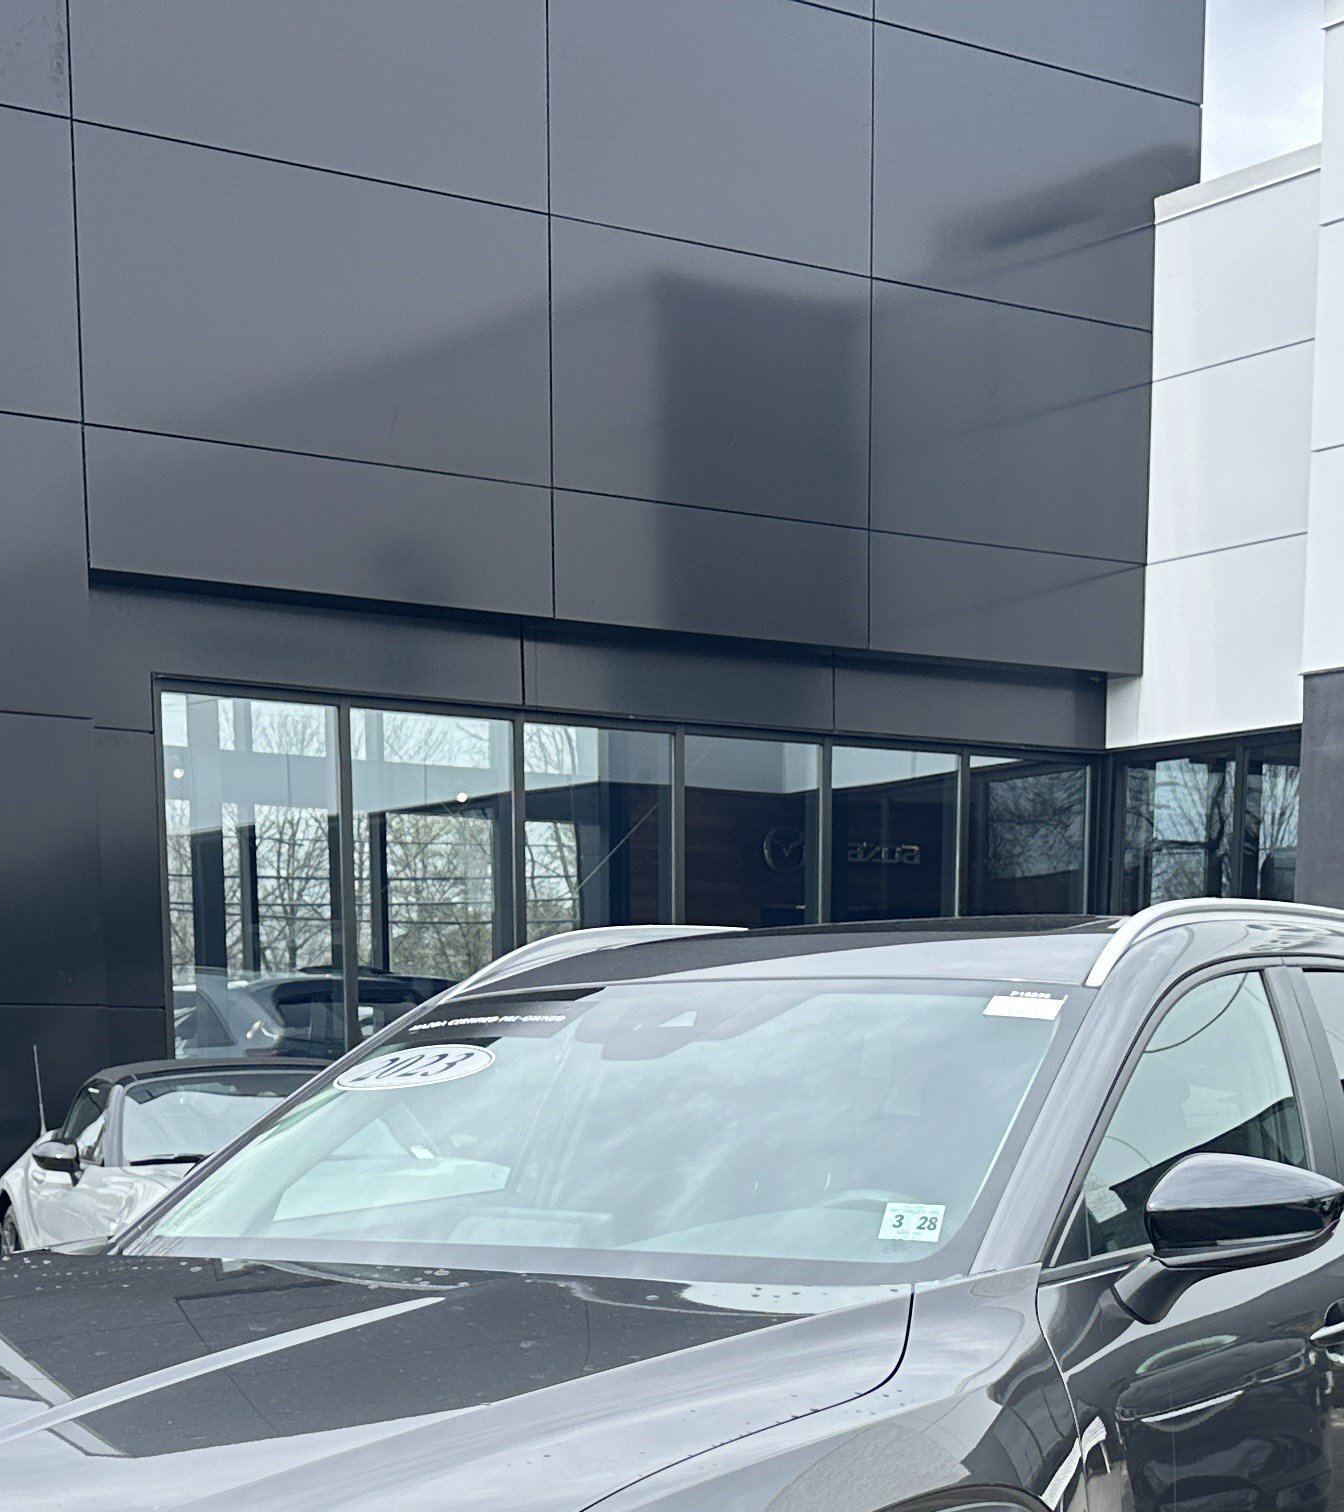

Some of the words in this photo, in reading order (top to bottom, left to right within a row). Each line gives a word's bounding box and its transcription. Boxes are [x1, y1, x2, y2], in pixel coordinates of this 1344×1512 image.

[348, 1052, 476, 1084] 2023
[892, 1214, 905, 1228] 3
[916, 1216, 938, 1231] 28
